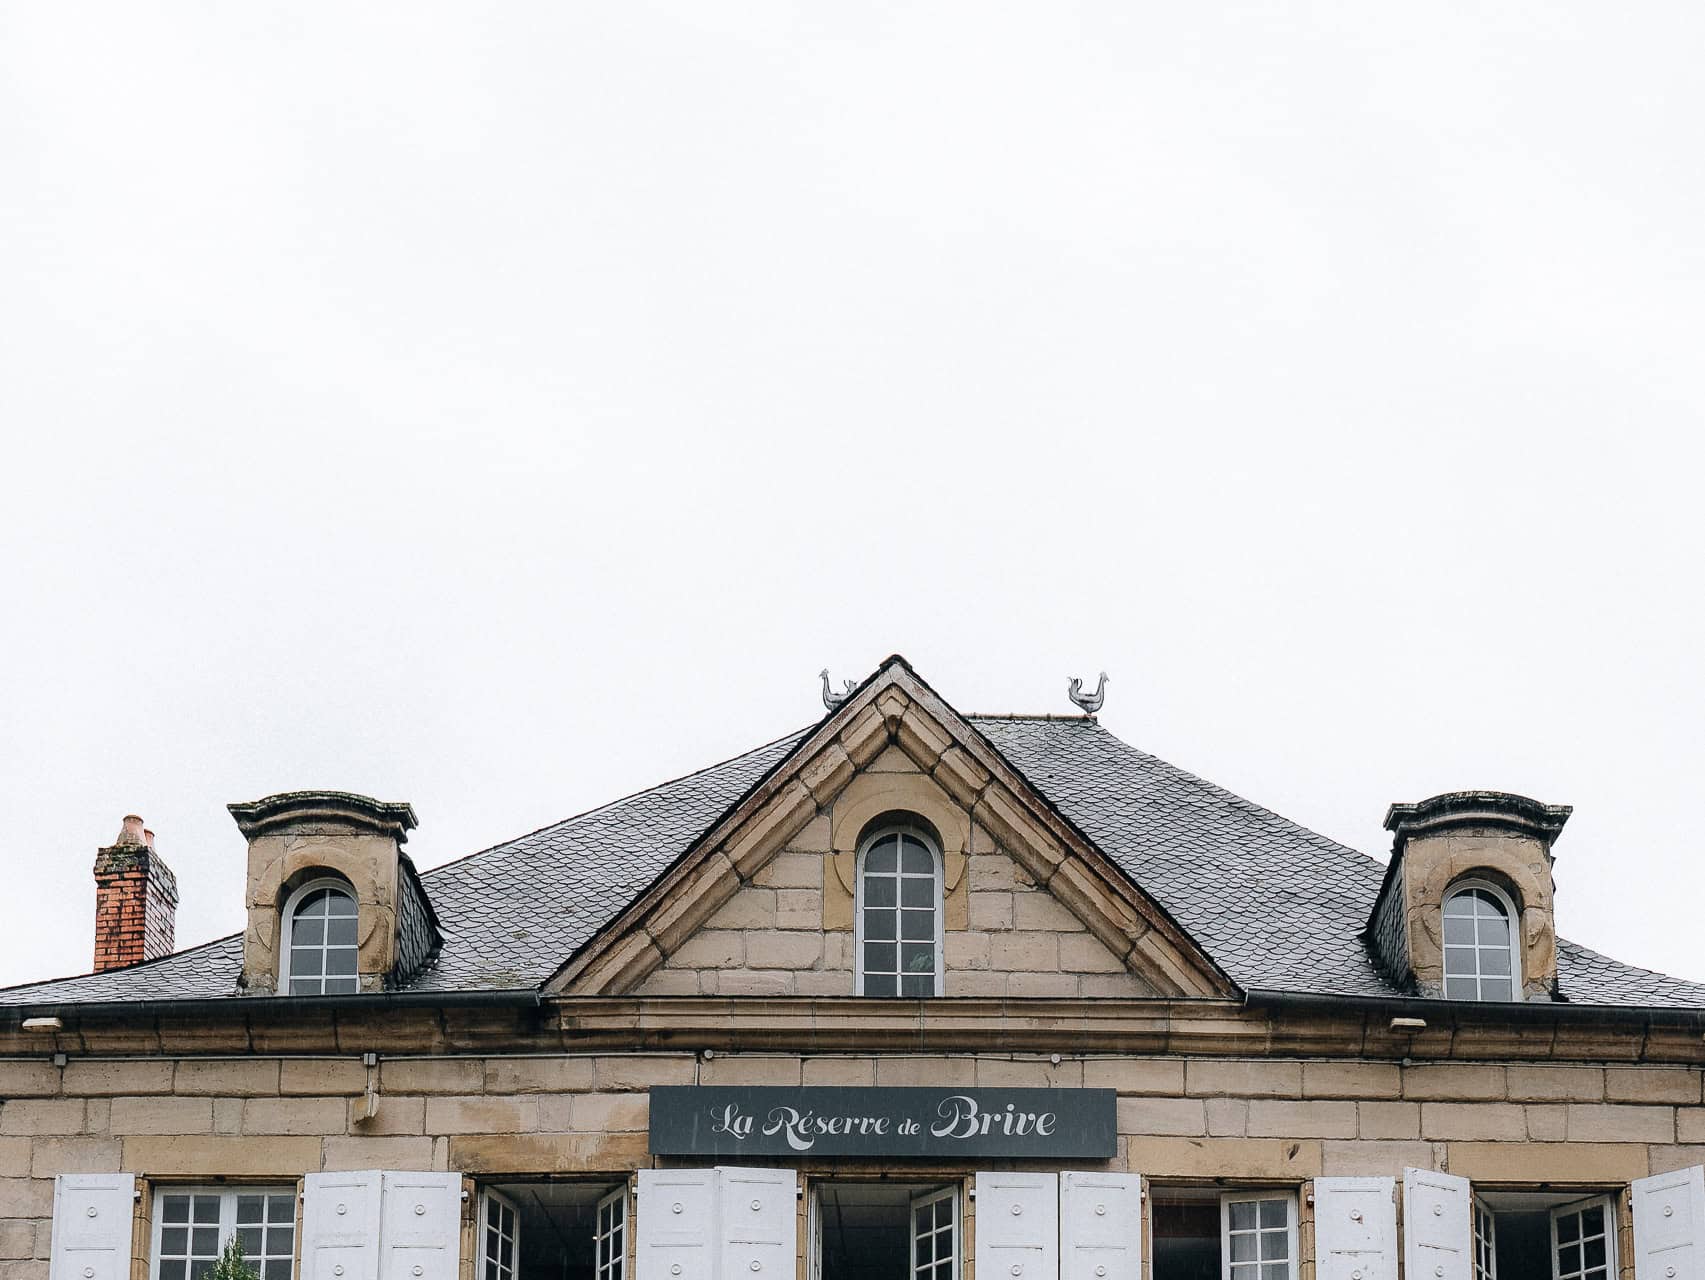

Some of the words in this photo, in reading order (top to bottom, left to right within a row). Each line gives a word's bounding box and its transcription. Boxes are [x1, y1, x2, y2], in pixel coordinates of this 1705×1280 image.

[710, 1102, 753, 1139] La
[762, 1106, 889, 1150] Réserve
[898, 1119, 920, 1135] de
[930, 1096, 1056, 1138] Brive
